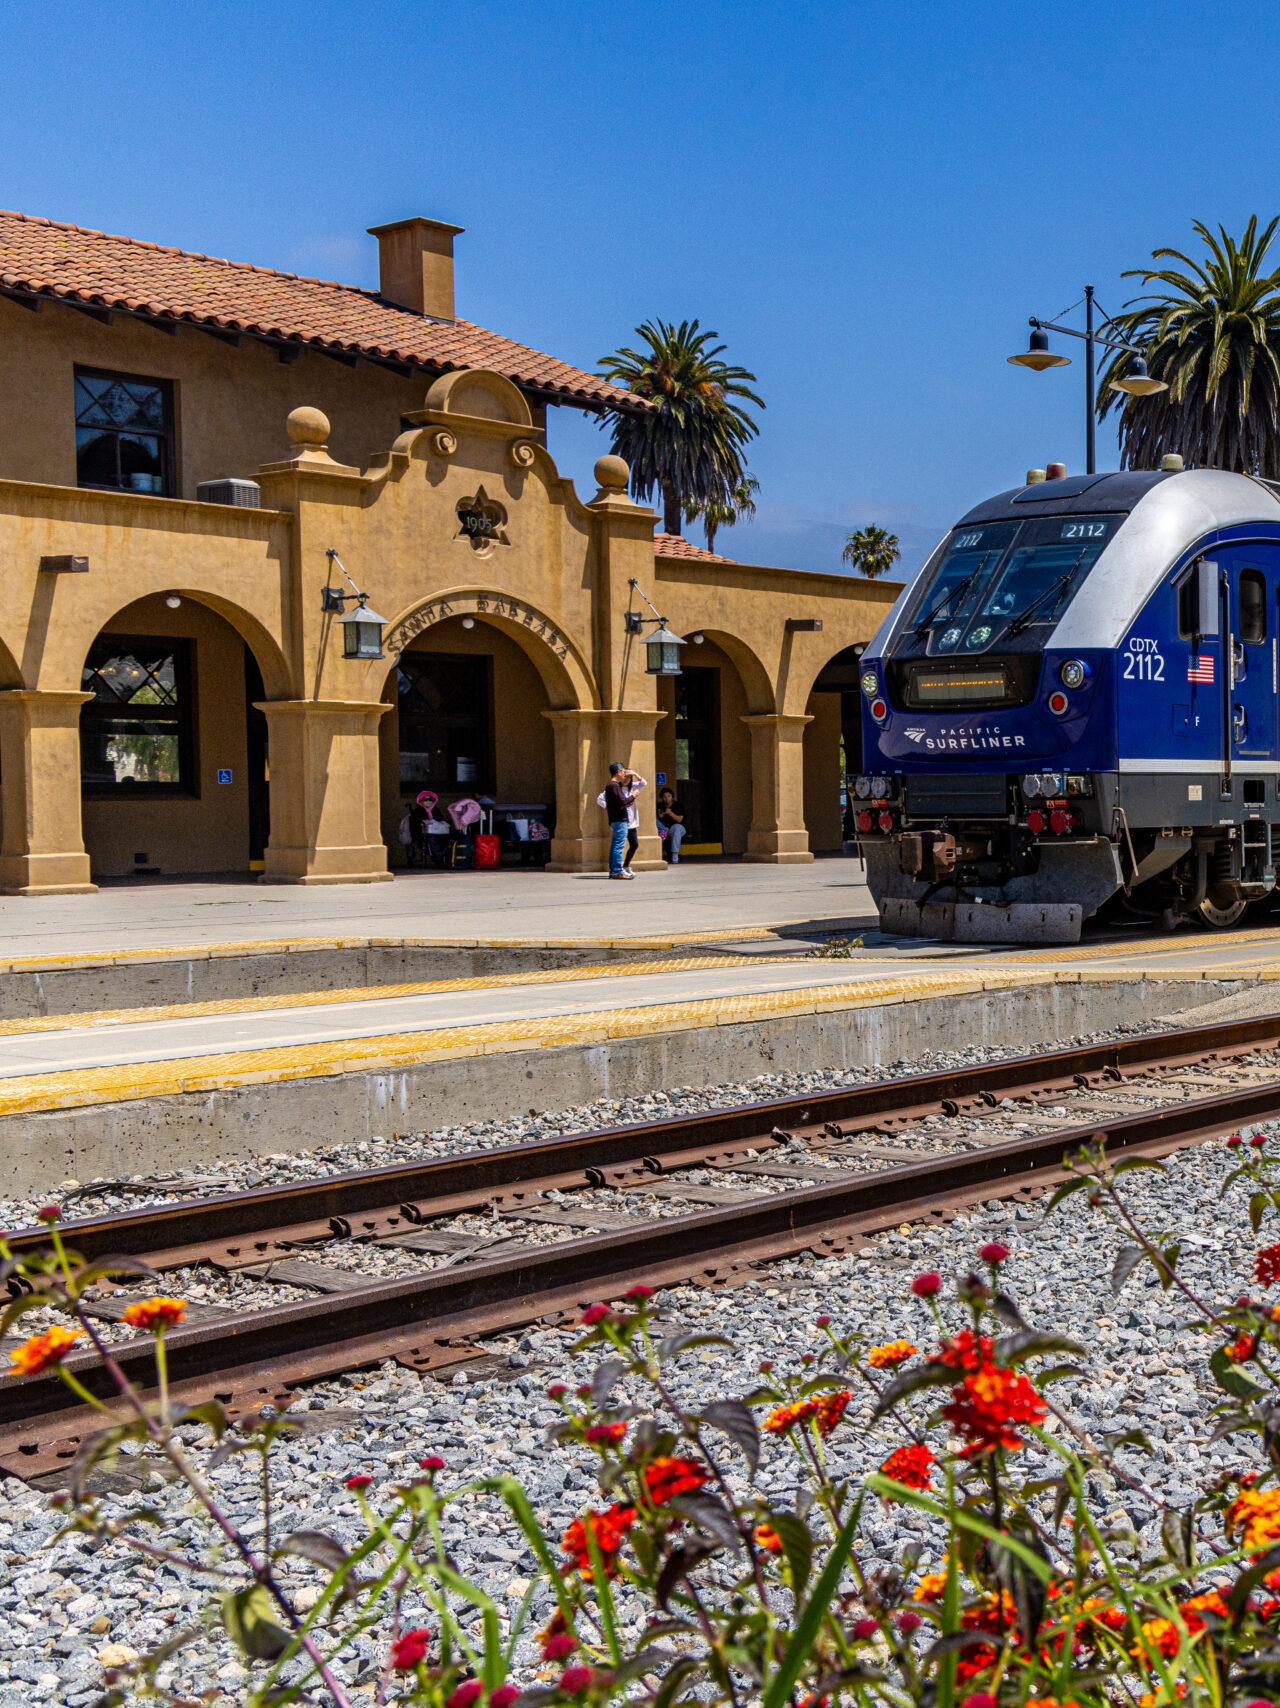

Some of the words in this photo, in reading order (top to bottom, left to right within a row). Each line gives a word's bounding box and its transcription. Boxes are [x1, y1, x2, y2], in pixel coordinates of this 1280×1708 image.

[466, 516, 492, 533] 1905
[1066, 524, 1105, 537] 2112
[956, 533, 983, 547] 2112
[1129, 637, 1158, 653] CDTX
[1123, 652, 1165, 682] 2112
[1195, 716, 1200, 727] F
[941, 727, 1001, 736] PACIFIC
[926, 736, 1025, 749] SURFLINER
